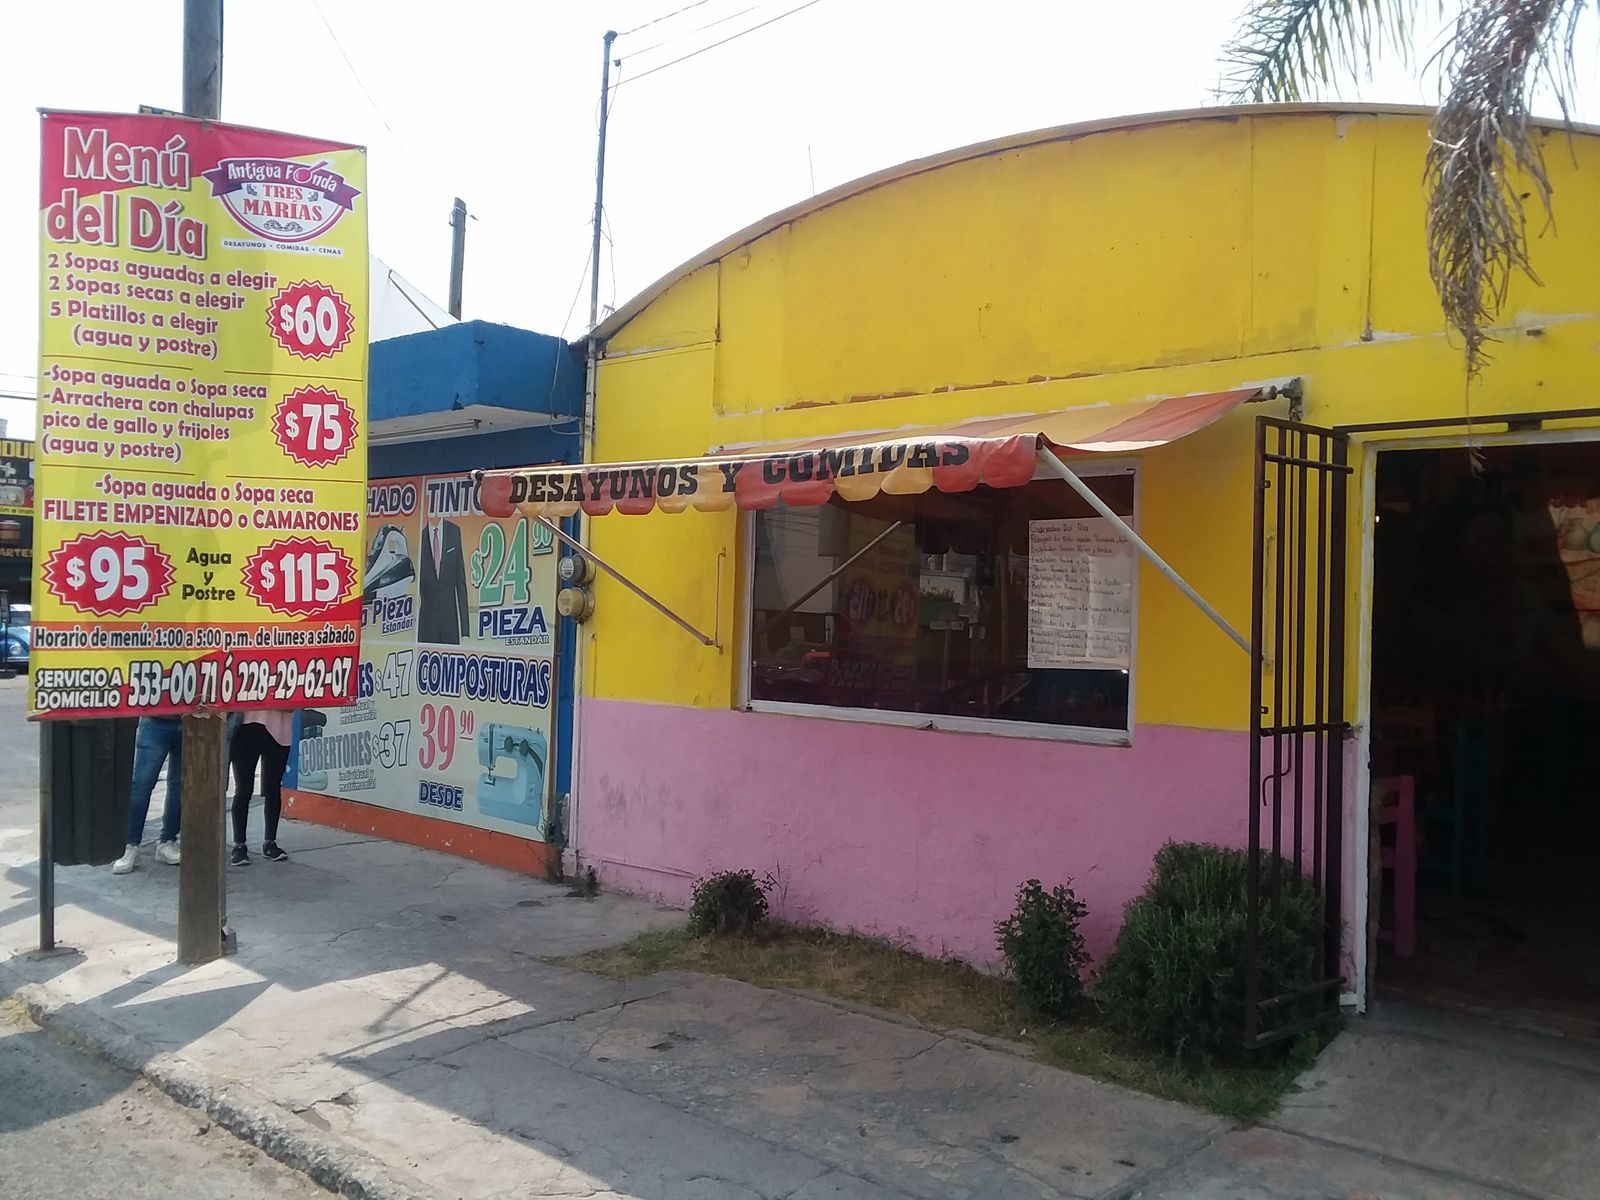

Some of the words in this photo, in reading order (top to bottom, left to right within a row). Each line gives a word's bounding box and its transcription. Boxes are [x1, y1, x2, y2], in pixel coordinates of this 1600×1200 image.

[64, 127, 190, 190] Menú
[263, 185, 303, 200] TRES
[47, 187, 115, 245] del
[129, 195, 206, 259] Día
[243, 198, 323, 222] MARÍAS
[224, 240, 267, 249] DESAYUNOS
[276, 243, 309, 253] COMIDAS
[318, 247, 342, 256] CENAS
[49, 253, 58, 269] 2
[66, 254, 119, 277] Sopas
[125, 264, 204, 286] aguadas
[210, 273, 221, 286] a
[226, 271, 277, 293] elegir
[49, 275, 60, 290] 2
[66, 274, 121, 298] Sopas
[127, 286, 174, 303] secas
[180, 292, 191, 304] a
[195, 291, 245, 315] elegir
[50, 301, 61, 316] 5
[68, 300, 146, 325] Platillos
[151, 314, 163, 327] a
[169, 313, 218, 337] elegir
[280, 295, 338, 346] $60
[73, 326, 132, 350] (agua
[138, 335, 150, 352] y
[156, 336, 218, 361] postre)
[43, 365, 96, 388] -Sopa
[101, 369, 171, 394] aguada
[176, 379, 186, 393] o
[190, 379, 227, 401] Sopa
[232, 384, 267, 399] seca
[43, 388, 143, 411] -Arrachera
[149, 400, 177, 414] con
[183, 400, 254, 422] chalupas
[42, 412, 80, 431] pico
[86, 414, 108, 431] de
[113, 416, 158, 440] gallo
[162, 422, 174, 438] y
[178, 420, 230, 442] frijoles
[286, 404, 342, 450] $75
[42, 437, 98, 456] (agua
[104, 440, 115, 457] y
[120, 439, 183, 463] postre)
[509, 466, 698, 503] DESAYUNOS
[722, 462, 742, 492] Y
[763, 442, 969, 484] COMIDAS
[96, 474, 146, 499] -Sopa
[151, 482, 217, 506] aguada
[220, 487, 231, 500] o
[235, 482, 275, 505] Sopa
[280, 487, 314, 504] seca
[44, 499, 108, 523] FILETE
[113, 503, 233, 529] EMPENIZADO
[238, 516, 248, 529] o
[253, 509, 359, 532] CAMARONES
[186, 547, 231, 566] Agua
[66, 546, 149, 601] $95
[203, 569, 214, 585] y
[261, 552, 340, 602] $115
[182, 584, 236, 601] Postre
[373, 596, 413, 624] Pieza
[383, 617, 414, 634] Estandar
[479, 607, 547, 637] PIEZA
[35, 628, 88, 648] Horario
[89, 629, 107, 648] de
[109, 623, 152, 649] menú:
[155, 629, 184, 648] 1:00
[186, 633, 195, 647] a
[196, 629, 221, 648] 5:00
[224, 632, 252, 652] p.m.
[255, 627, 271, 646] de
[273, 627, 305, 646] lunes
[307, 632, 315, 646] a
[317, 622, 355, 645] sábado
[506, 635, 549, 646] ESTANDAR
[36, 669, 107, 689] SERVICIO
[109, 669, 122, 686] A
[128, 662, 197, 707] 553-00
[201, 661, 218, 703] 71
[221, 654, 233, 703] ó
[236, 657, 352, 702] 228-29-62-07
[375, 651, 413, 698] $47
[418, 652, 550, 706] COMPOSTURAS
[36, 690, 120, 709] DOMICILIO
[301, 731, 372, 773] COBERTORES
[373, 720, 411, 768] $37
[419, 704, 455, 770] 39
[460, 711, 474, 735] 90
[419, 780, 463, 810] DESDE
